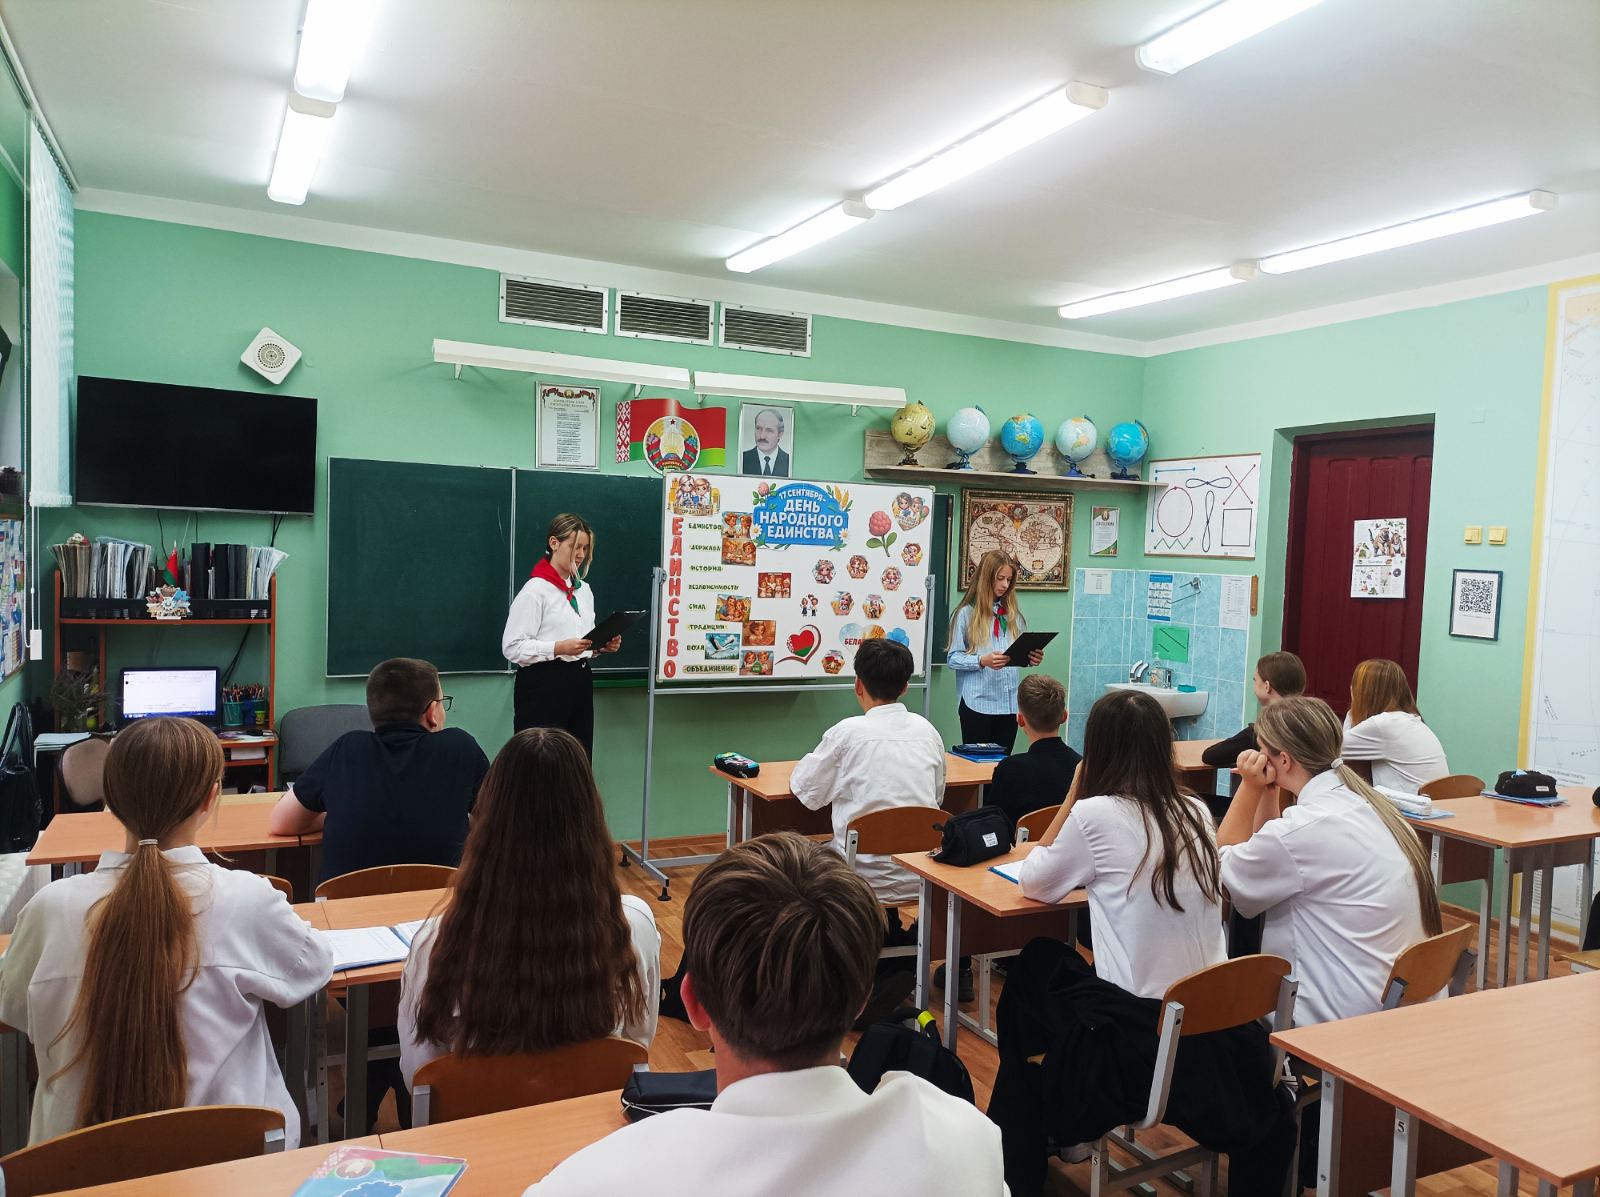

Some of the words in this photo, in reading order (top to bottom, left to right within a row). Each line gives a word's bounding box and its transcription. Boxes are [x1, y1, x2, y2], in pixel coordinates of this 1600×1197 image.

[779, 492, 787, 500] 17
[784, 499, 820, 513] ДЕНЬ
[760, 511, 844, 527] НАРОДНОГО
[767, 525, 834, 539] ЕДИНСТВА
[664, 517, 684, 678] ЕДИНСТВО
[686, 664, 735, 673] ОБЪЕДИНЕНИЕ
[1397, 1120, 1405, 1133] 5
